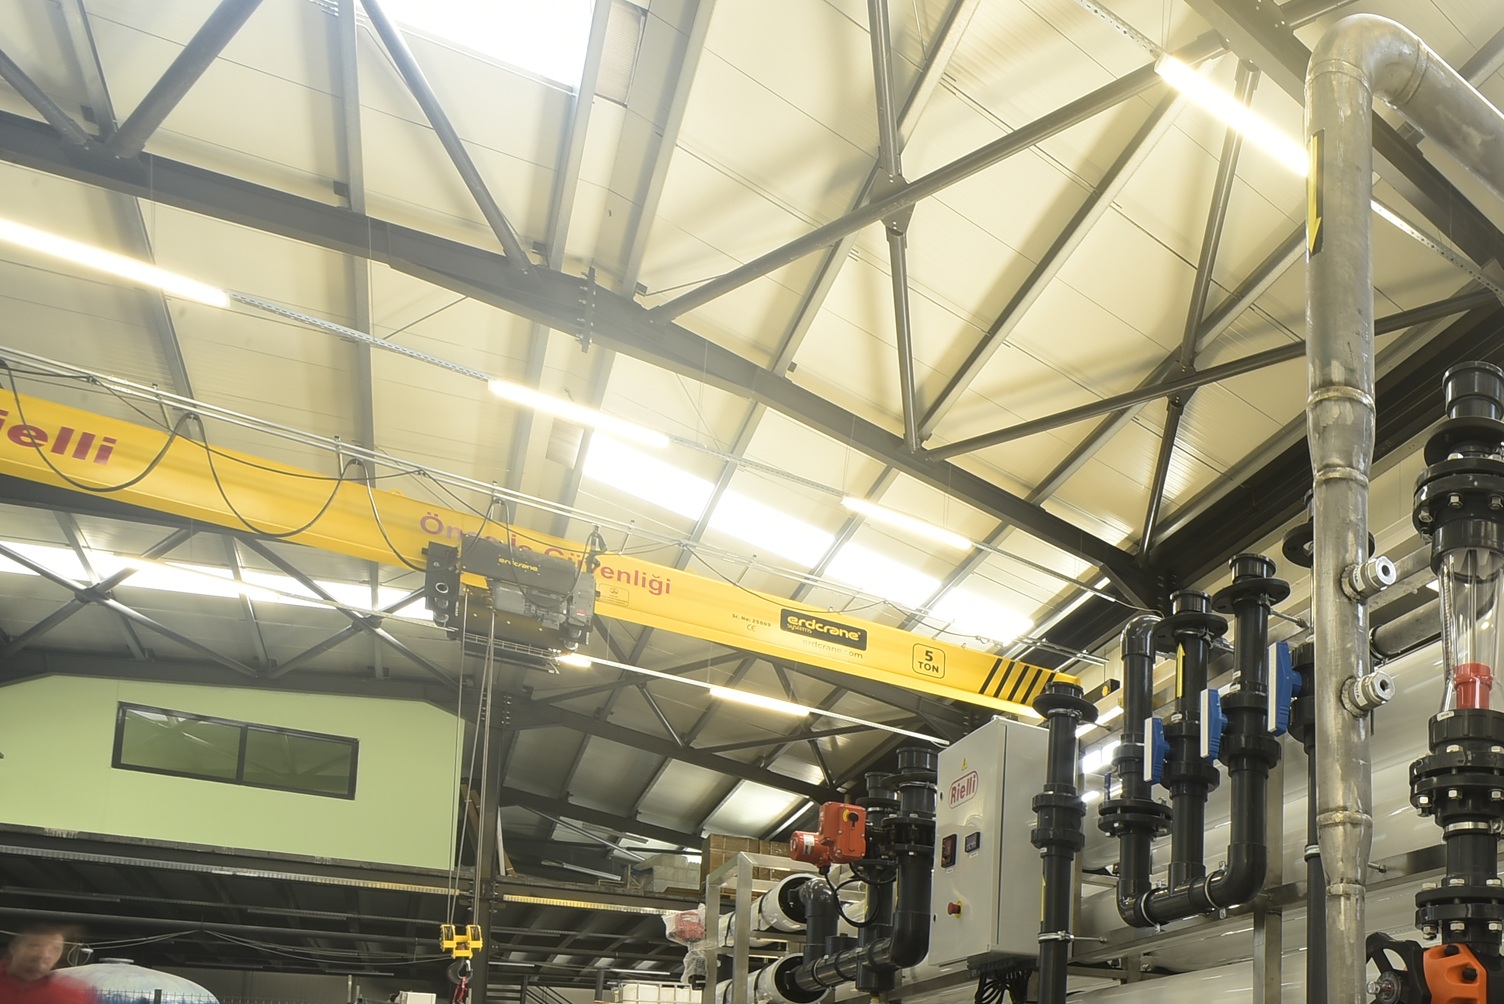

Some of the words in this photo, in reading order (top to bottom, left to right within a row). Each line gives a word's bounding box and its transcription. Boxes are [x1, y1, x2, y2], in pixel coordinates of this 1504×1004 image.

[787, 616, 860, 641] erdcrane
[924, 650, 934, 662] 5
[917, 660, 939, 674] TON
[951, 775, 975, 804] Rielli
